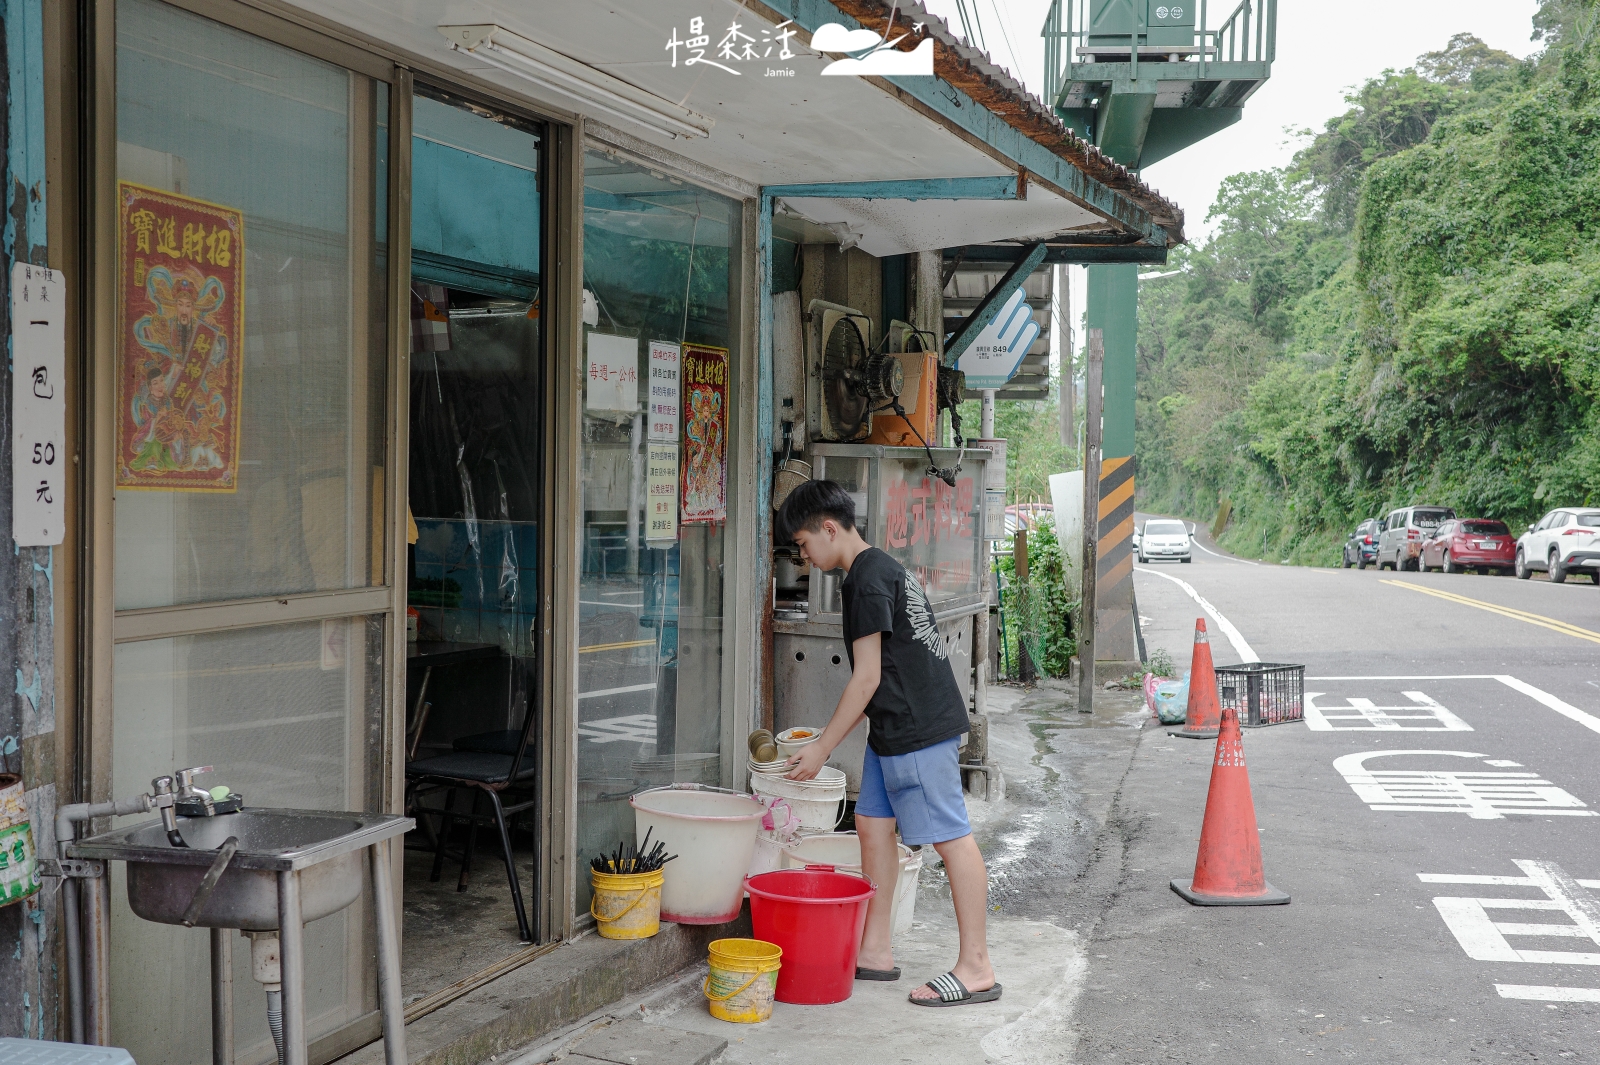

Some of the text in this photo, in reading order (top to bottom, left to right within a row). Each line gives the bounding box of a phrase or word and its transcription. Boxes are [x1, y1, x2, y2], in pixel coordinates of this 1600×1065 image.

[992, 345, 1007, 353] 849
[589, 361, 637, 383] 每週一公休
[885, 477, 974, 551] 越式料理
